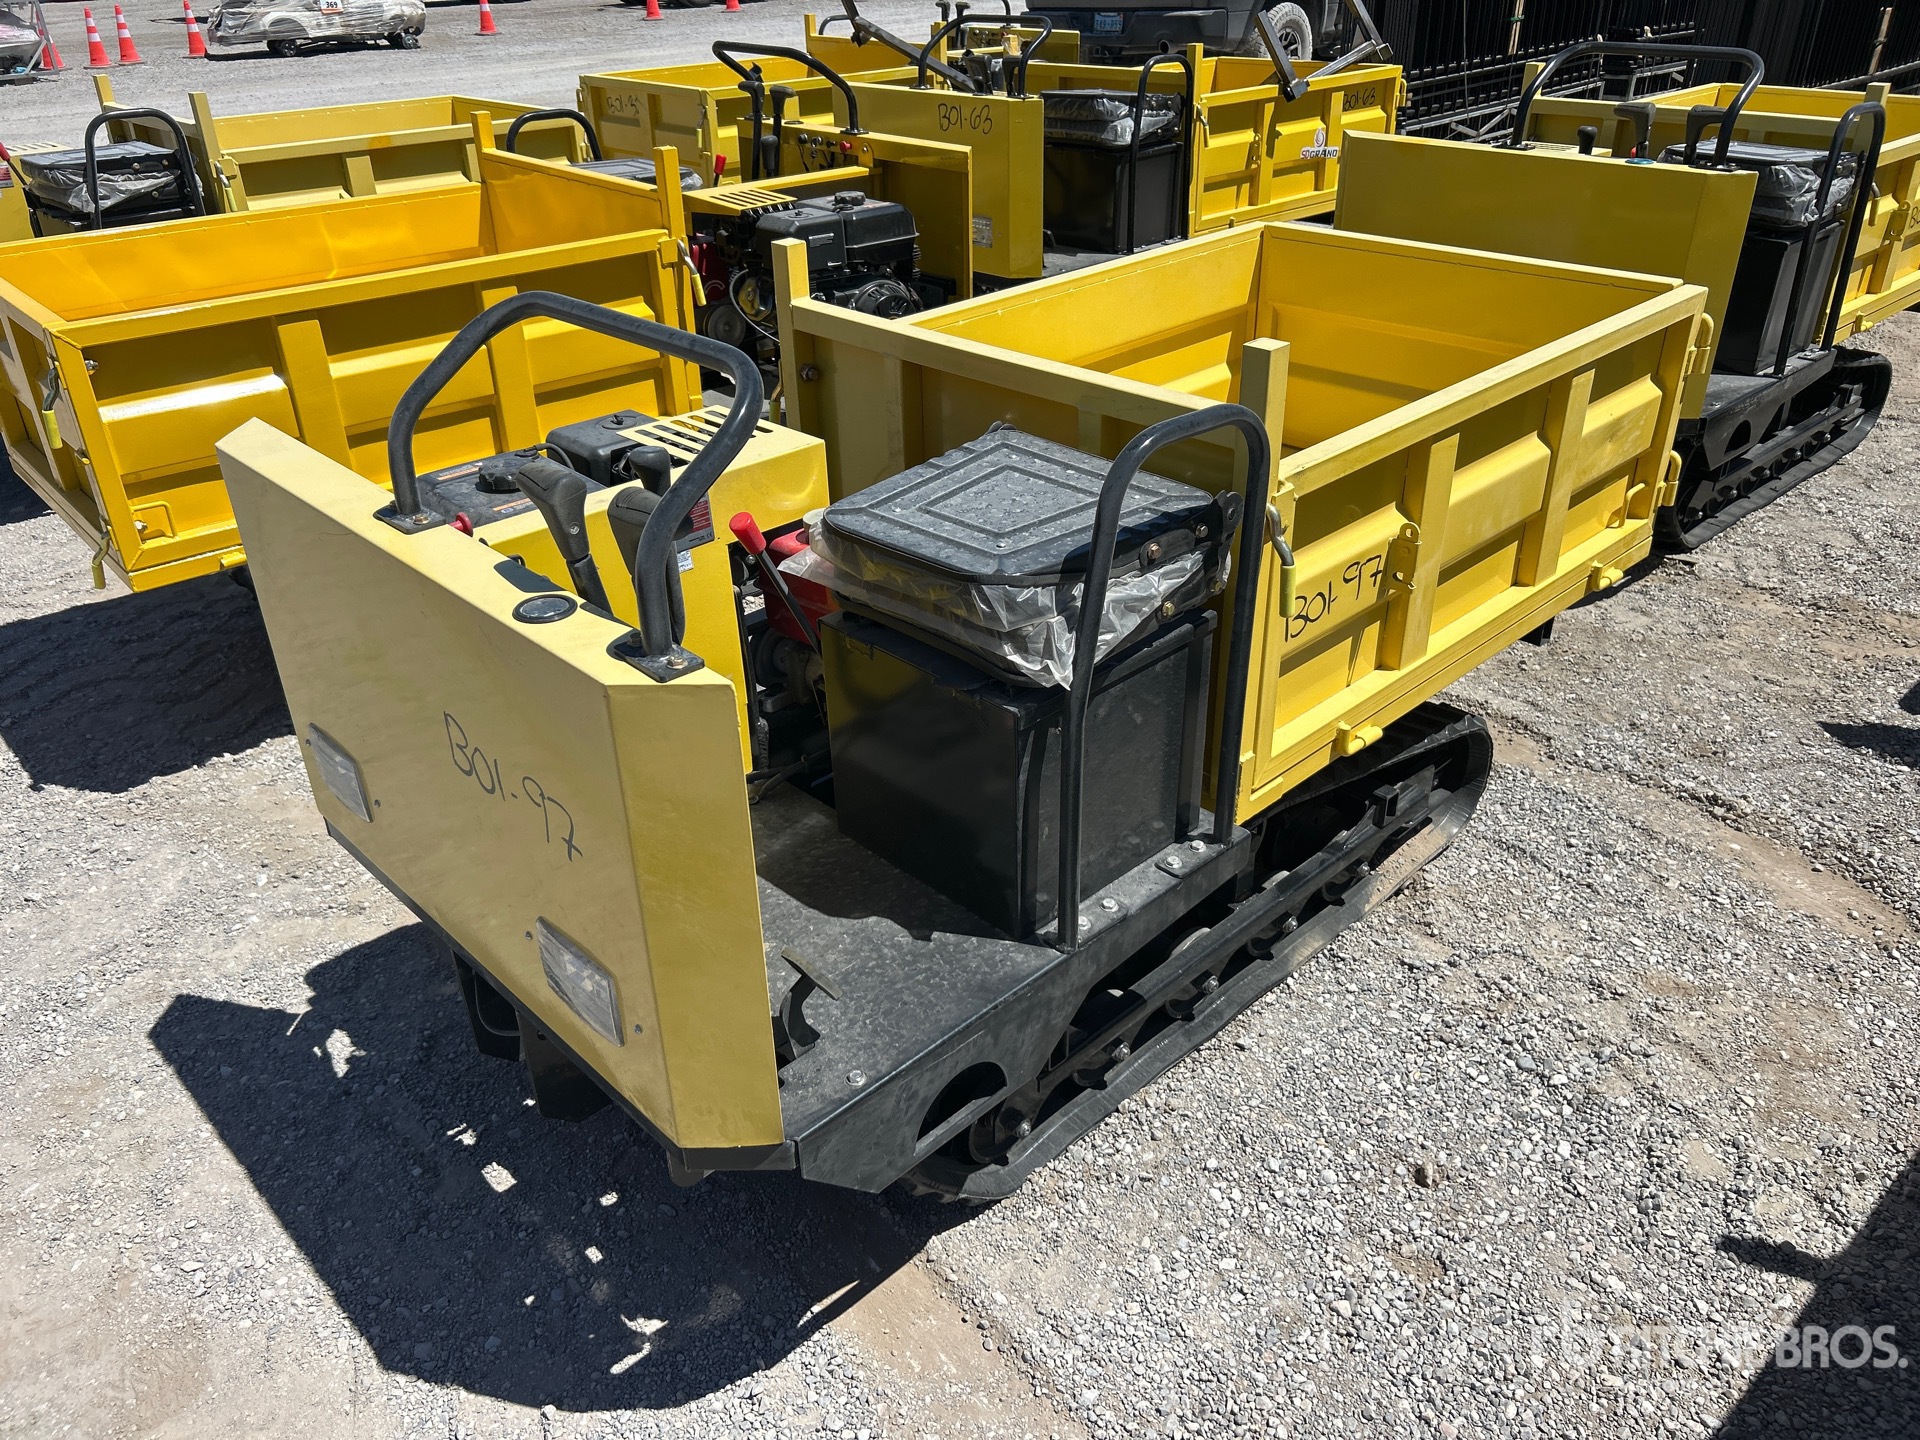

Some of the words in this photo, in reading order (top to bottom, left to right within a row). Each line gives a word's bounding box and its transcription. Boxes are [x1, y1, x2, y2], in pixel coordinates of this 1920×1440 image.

[325, 1, 338, 9] 369
[1343, 87, 1376, 112] B01-63
[937, 103, 993, 135] B01-63
[1284, 554, 1383, 643] B01-97
[443, 710, 584, 863] B01-97
